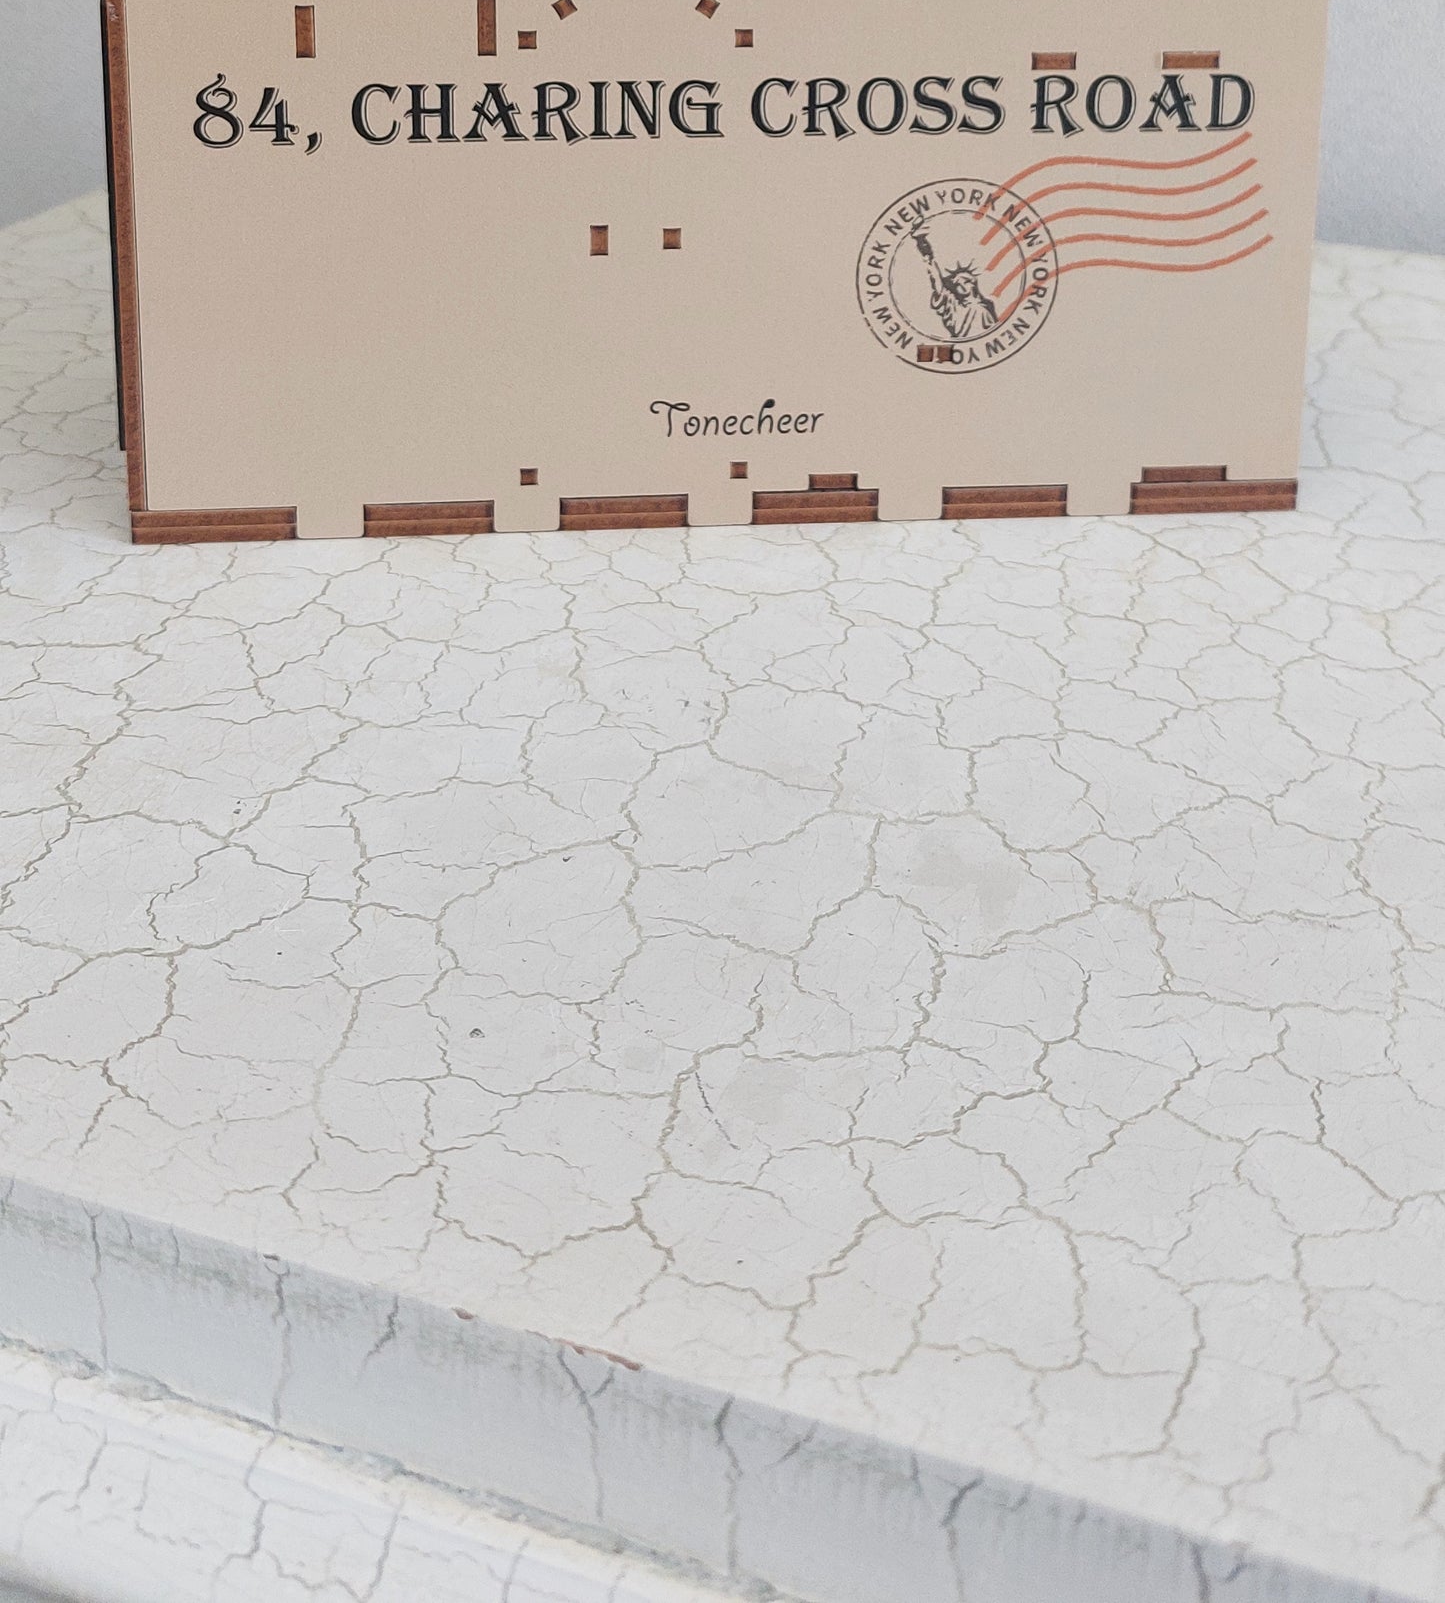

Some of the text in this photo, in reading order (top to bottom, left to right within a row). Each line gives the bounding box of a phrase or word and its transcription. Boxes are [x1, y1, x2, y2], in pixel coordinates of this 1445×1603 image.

[192, 73, 1256, 154] 84, CHARING CROSS ROAD
[884, 195, 931, 236] NEW
[935, 188, 996, 211] YORK
[1003, 204, 1044, 247] NEW
[866, 240, 891, 302] YORK
[1023, 253, 1048, 315] YORK
[872, 306, 913, 349] NEW
[985, 317, 1031, 358] NEW
[650, 398, 824, 437] Tonecheer
